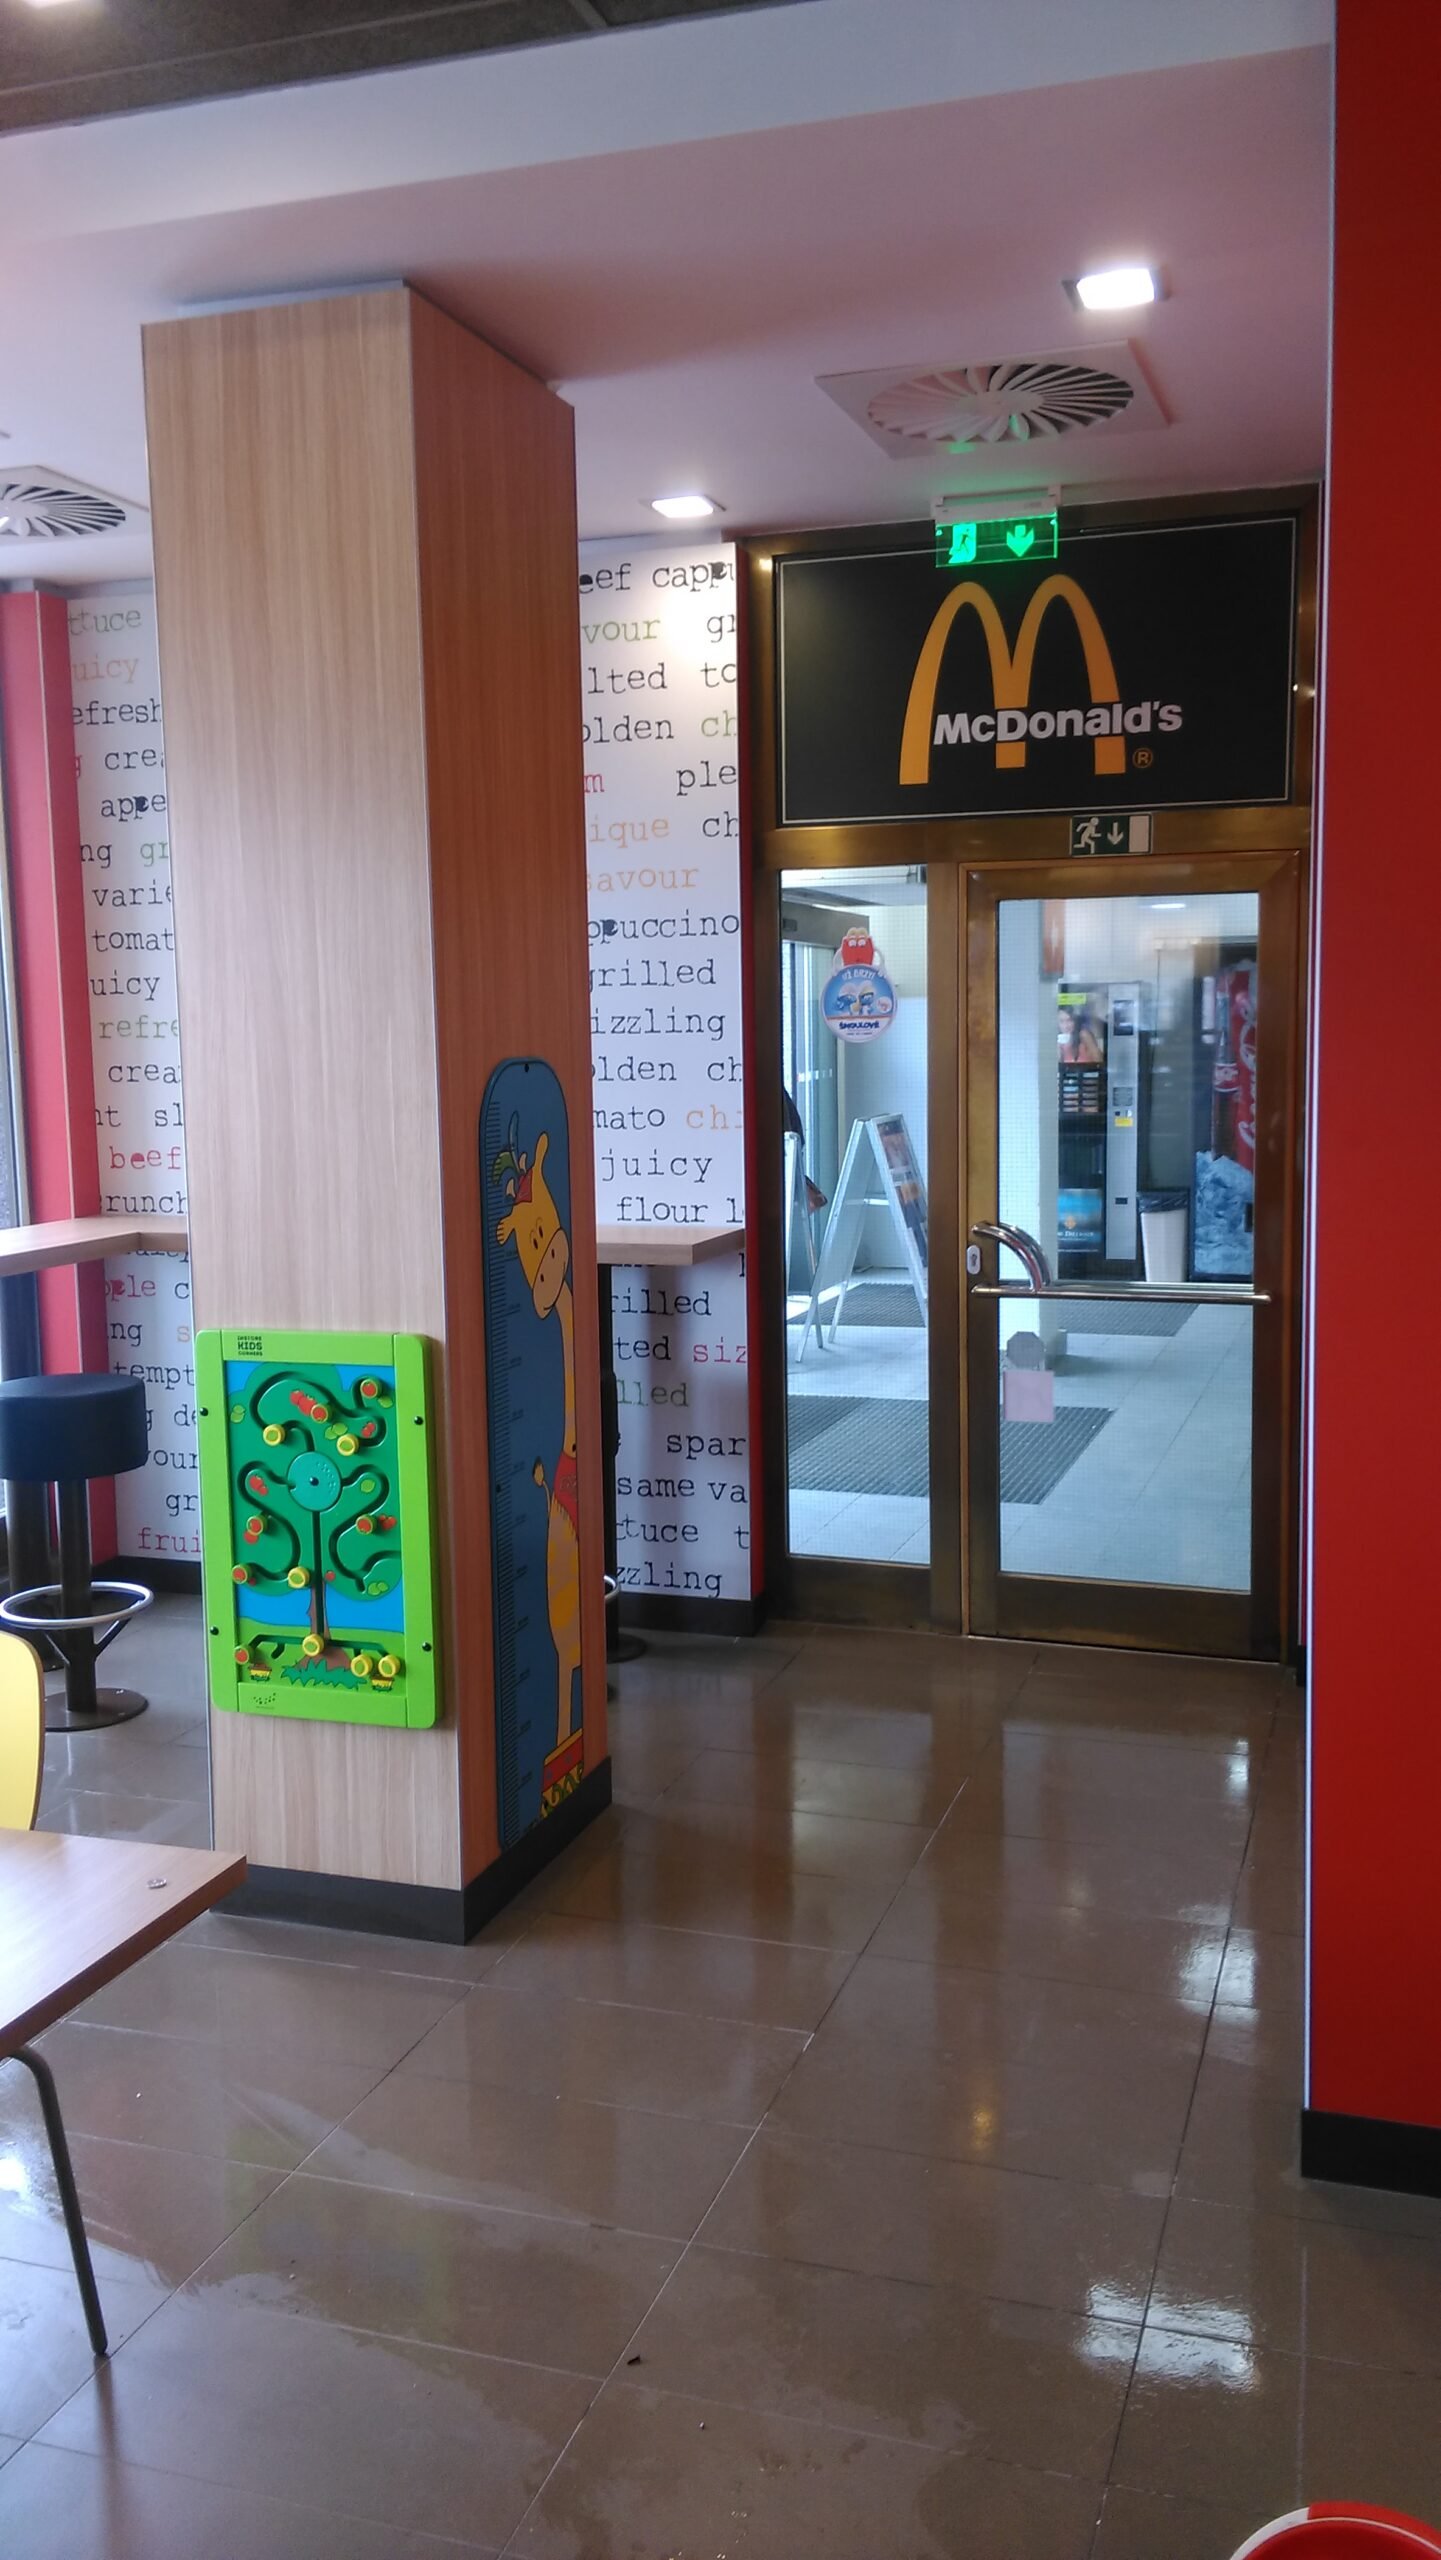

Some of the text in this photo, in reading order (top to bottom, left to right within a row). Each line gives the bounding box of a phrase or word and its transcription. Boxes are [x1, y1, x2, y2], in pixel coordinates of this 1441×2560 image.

[582, 620, 661, 645] vour
[73, 654, 138, 684] uicy
[587, 662, 668, 695] lted
[933, 700, 1184, 746] McDonald's
[104, 748, 164, 771] cre
[676, 760, 737, 797] ple
[589, 815, 670, 849] ique
[90, 969, 160, 1001] uicy
[591, 1006, 726, 1041] izzling
[108, 1063, 181, 1084] crea
[591, 1056, 678, 1082] lden
[109, 1146, 181, 1170] beef
[602, 1149, 713, 1183] juicy
[100, 1191, 186, 1214] runch
[617, 1197, 709, 1223] flour
[238, 1341, 263, 1351] KIDS
[616, 1336, 671, 1361] ted
[667, 1434, 746, 1460] spar
[617, 1476, 695, 1498] same
